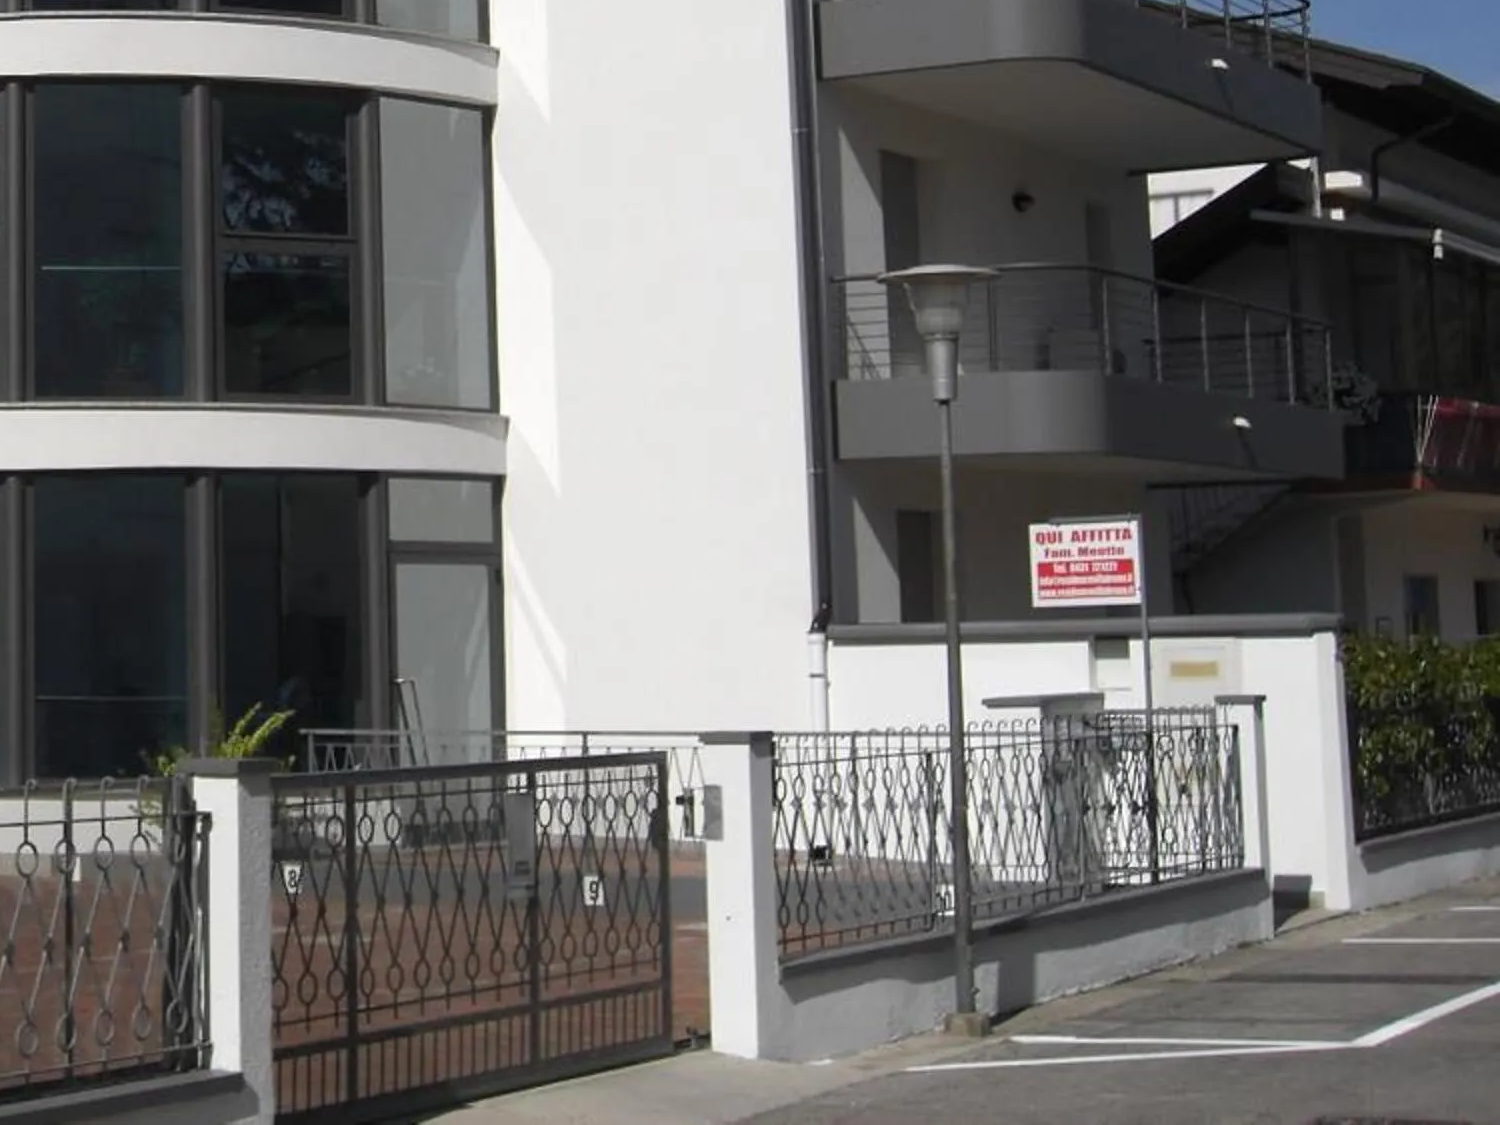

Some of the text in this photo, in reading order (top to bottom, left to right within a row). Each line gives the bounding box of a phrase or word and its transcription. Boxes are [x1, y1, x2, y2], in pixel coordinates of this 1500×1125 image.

[1036, 528, 1132, 544] QUI AFFITTA
[589, 880, 599, 900] 9
